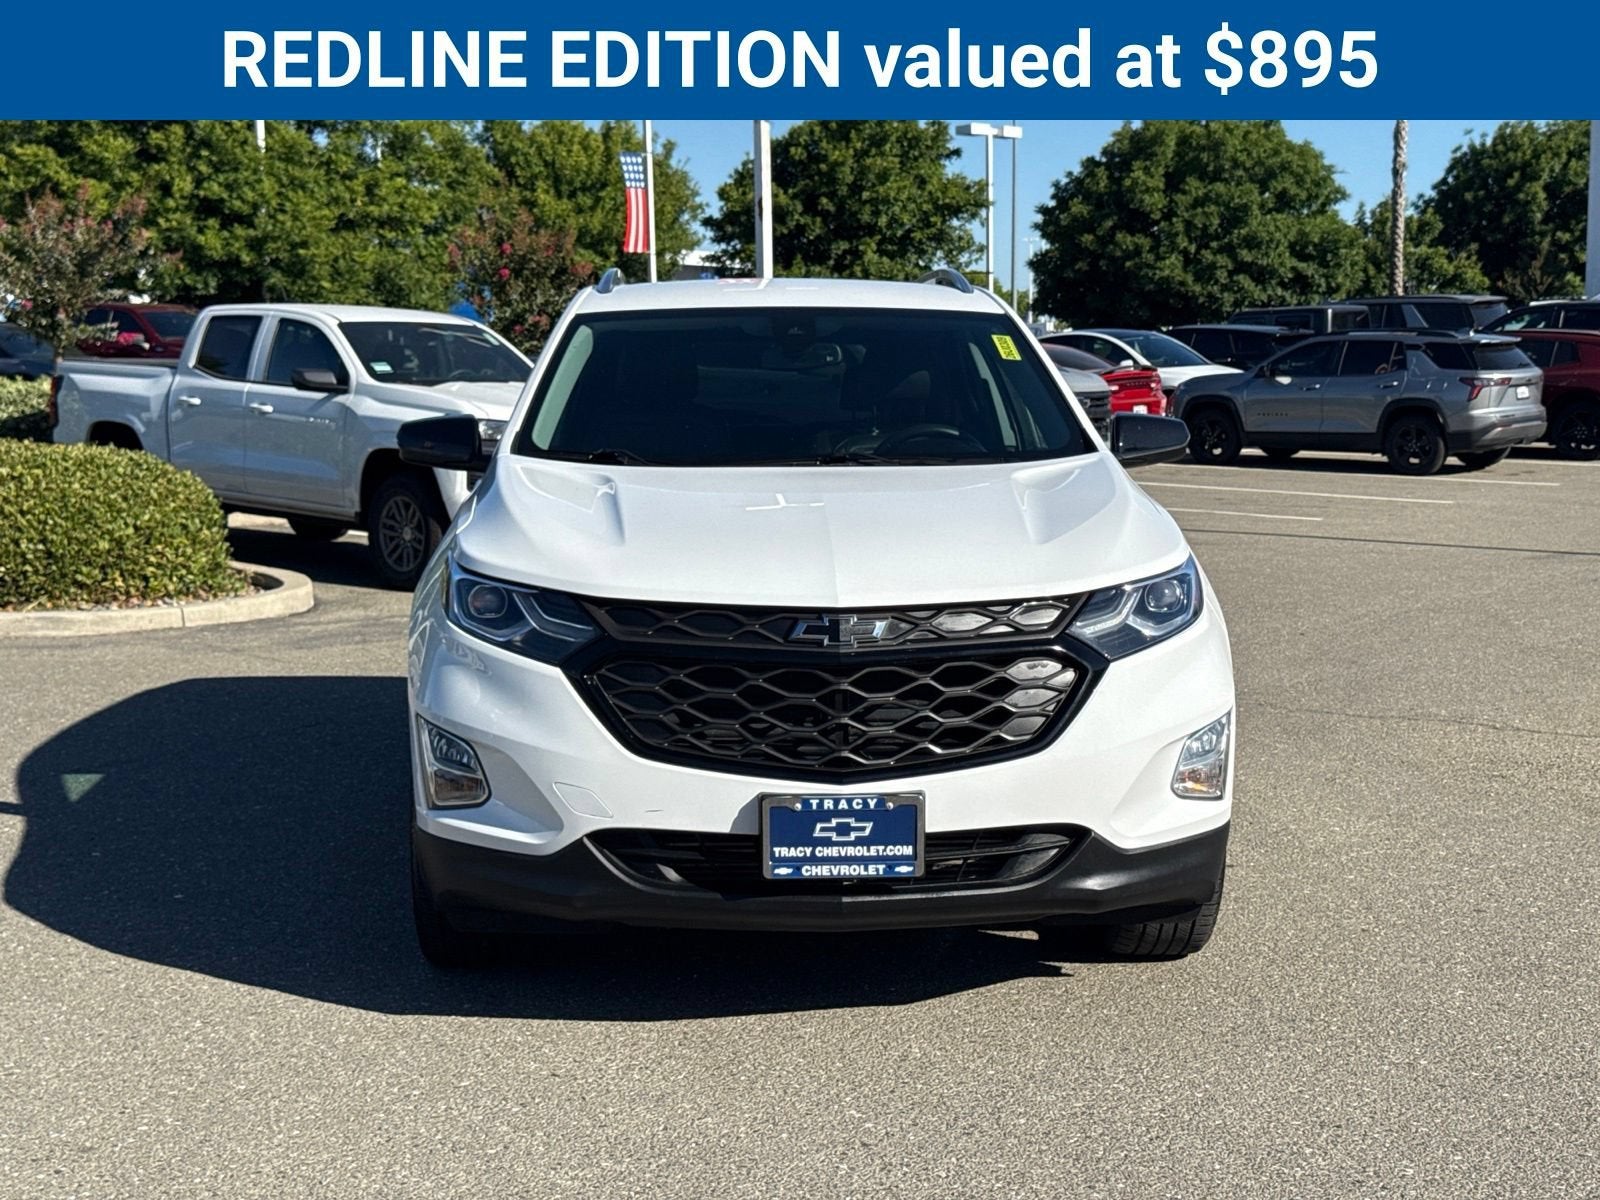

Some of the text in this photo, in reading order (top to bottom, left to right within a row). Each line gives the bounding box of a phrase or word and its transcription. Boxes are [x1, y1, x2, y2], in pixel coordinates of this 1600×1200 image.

[809, 799, 878, 810] TRACY
[773, 845, 913, 857] TRACY CHEVROLET.COM
[801, 864, 886, 876] CHEVROLET
